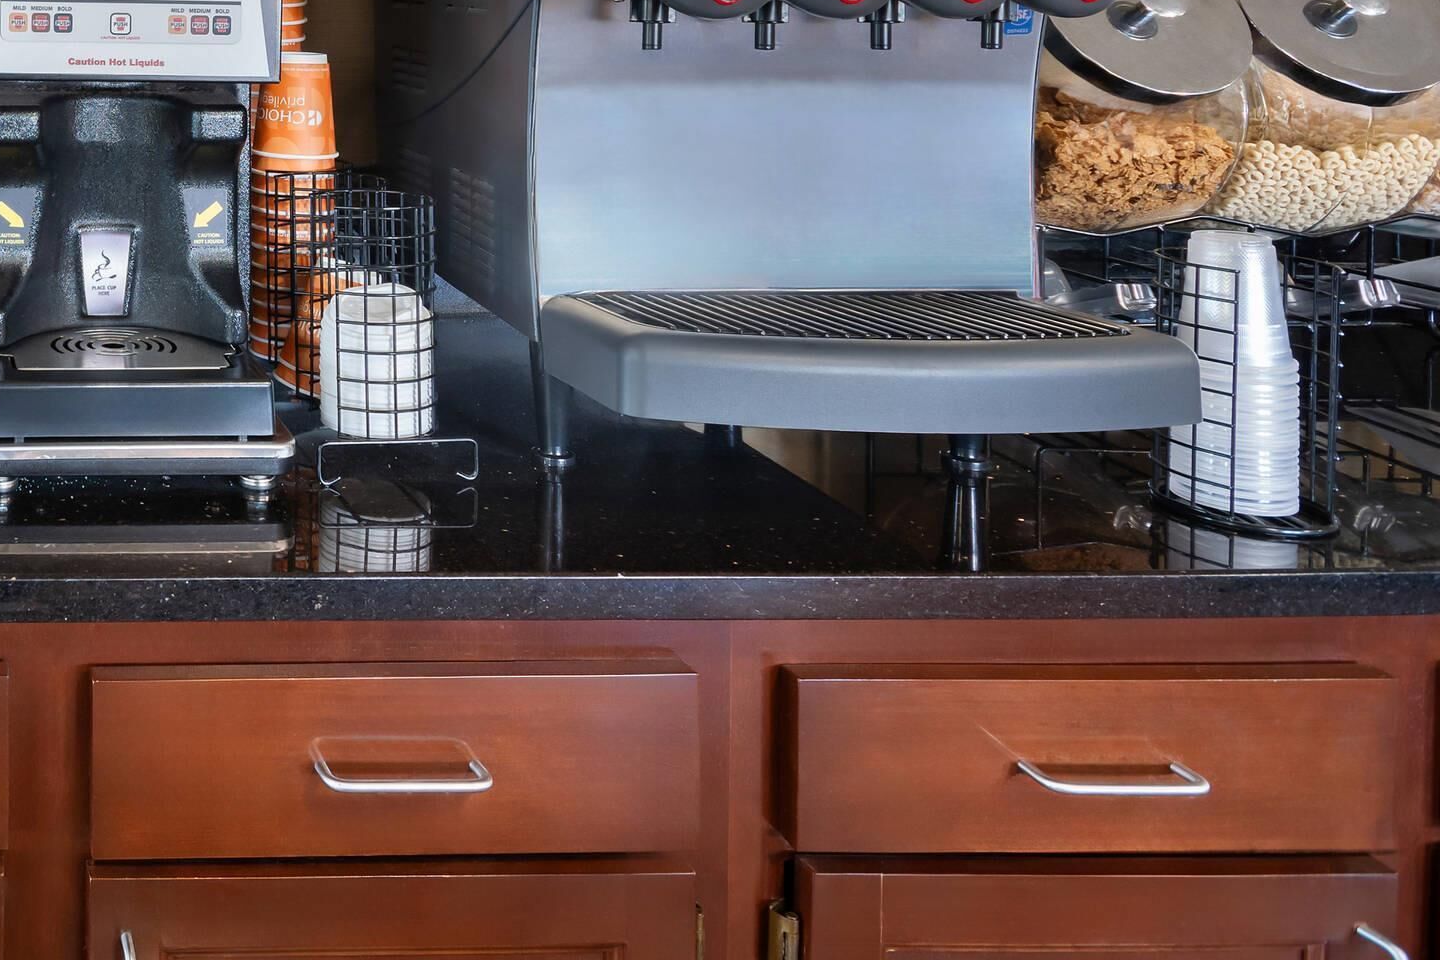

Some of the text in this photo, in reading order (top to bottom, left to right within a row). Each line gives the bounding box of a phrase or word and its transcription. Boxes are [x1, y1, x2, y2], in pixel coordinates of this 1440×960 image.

[68, 57, 165, 68] Caution Hot Liquids
